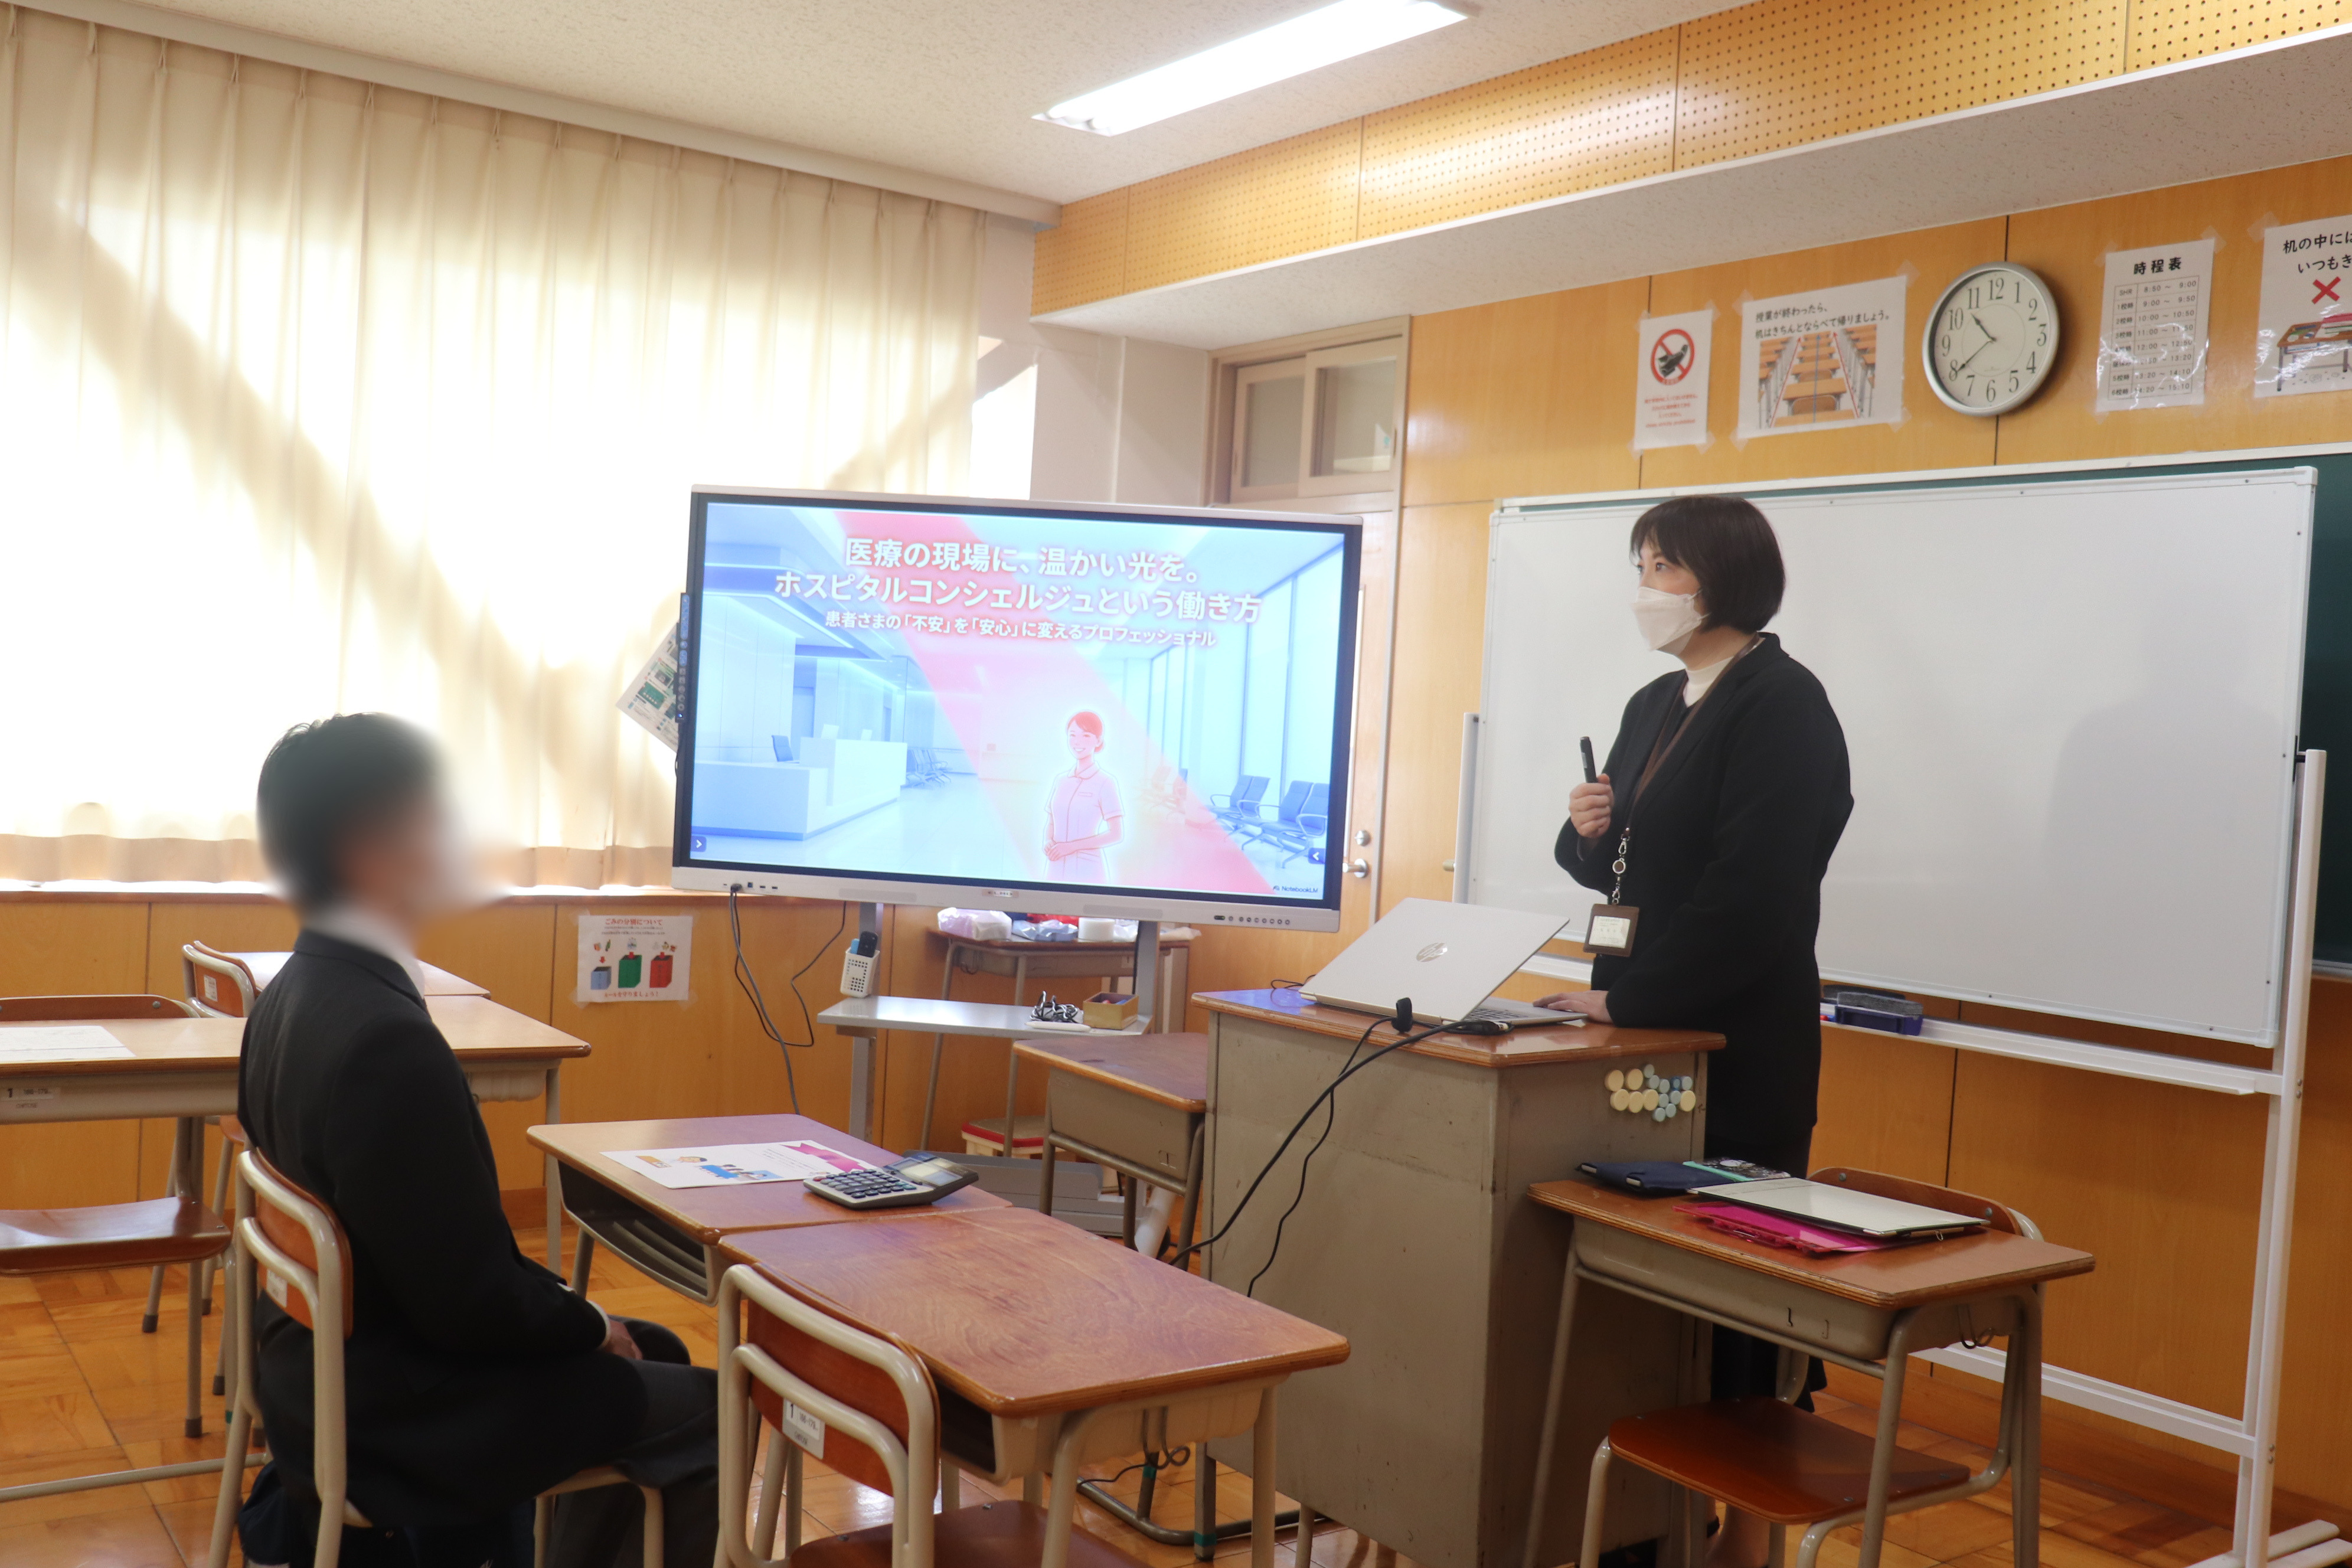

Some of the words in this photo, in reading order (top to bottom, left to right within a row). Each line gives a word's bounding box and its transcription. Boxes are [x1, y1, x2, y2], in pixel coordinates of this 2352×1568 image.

[2133, 256, 2182, 276] 時程表
[2298, 254, 2352, 273] いつもき
[1968, 288, 1979, 309] 11
[1988, 278, 2004, 300] 12
[2015, 282, 2020, 303] 1
[1948, 308, 1964, 331] 10
[2028, 298, 2037, 321] 2
[1942, 335, 1951, 357] 9
[2037, 324, 2047, 347] 3
[1949, 360, 1958, 381] 8
[2026, 351, 2036, 374] 4
[1966, 375, 1975, 397] 7
[1986, 380, 1995, 402] 6
[2009, 370, 2019, 393] 5
[846, 538, 1197, 583] 医療の現場に、温かい光を。
[775, 571, 1262, 623] ホスピタルコンシェルジュという働き方
[826, 611, 1217, 646] 患者さまの「不安」を「安心」に変えるプロフェッショナル
